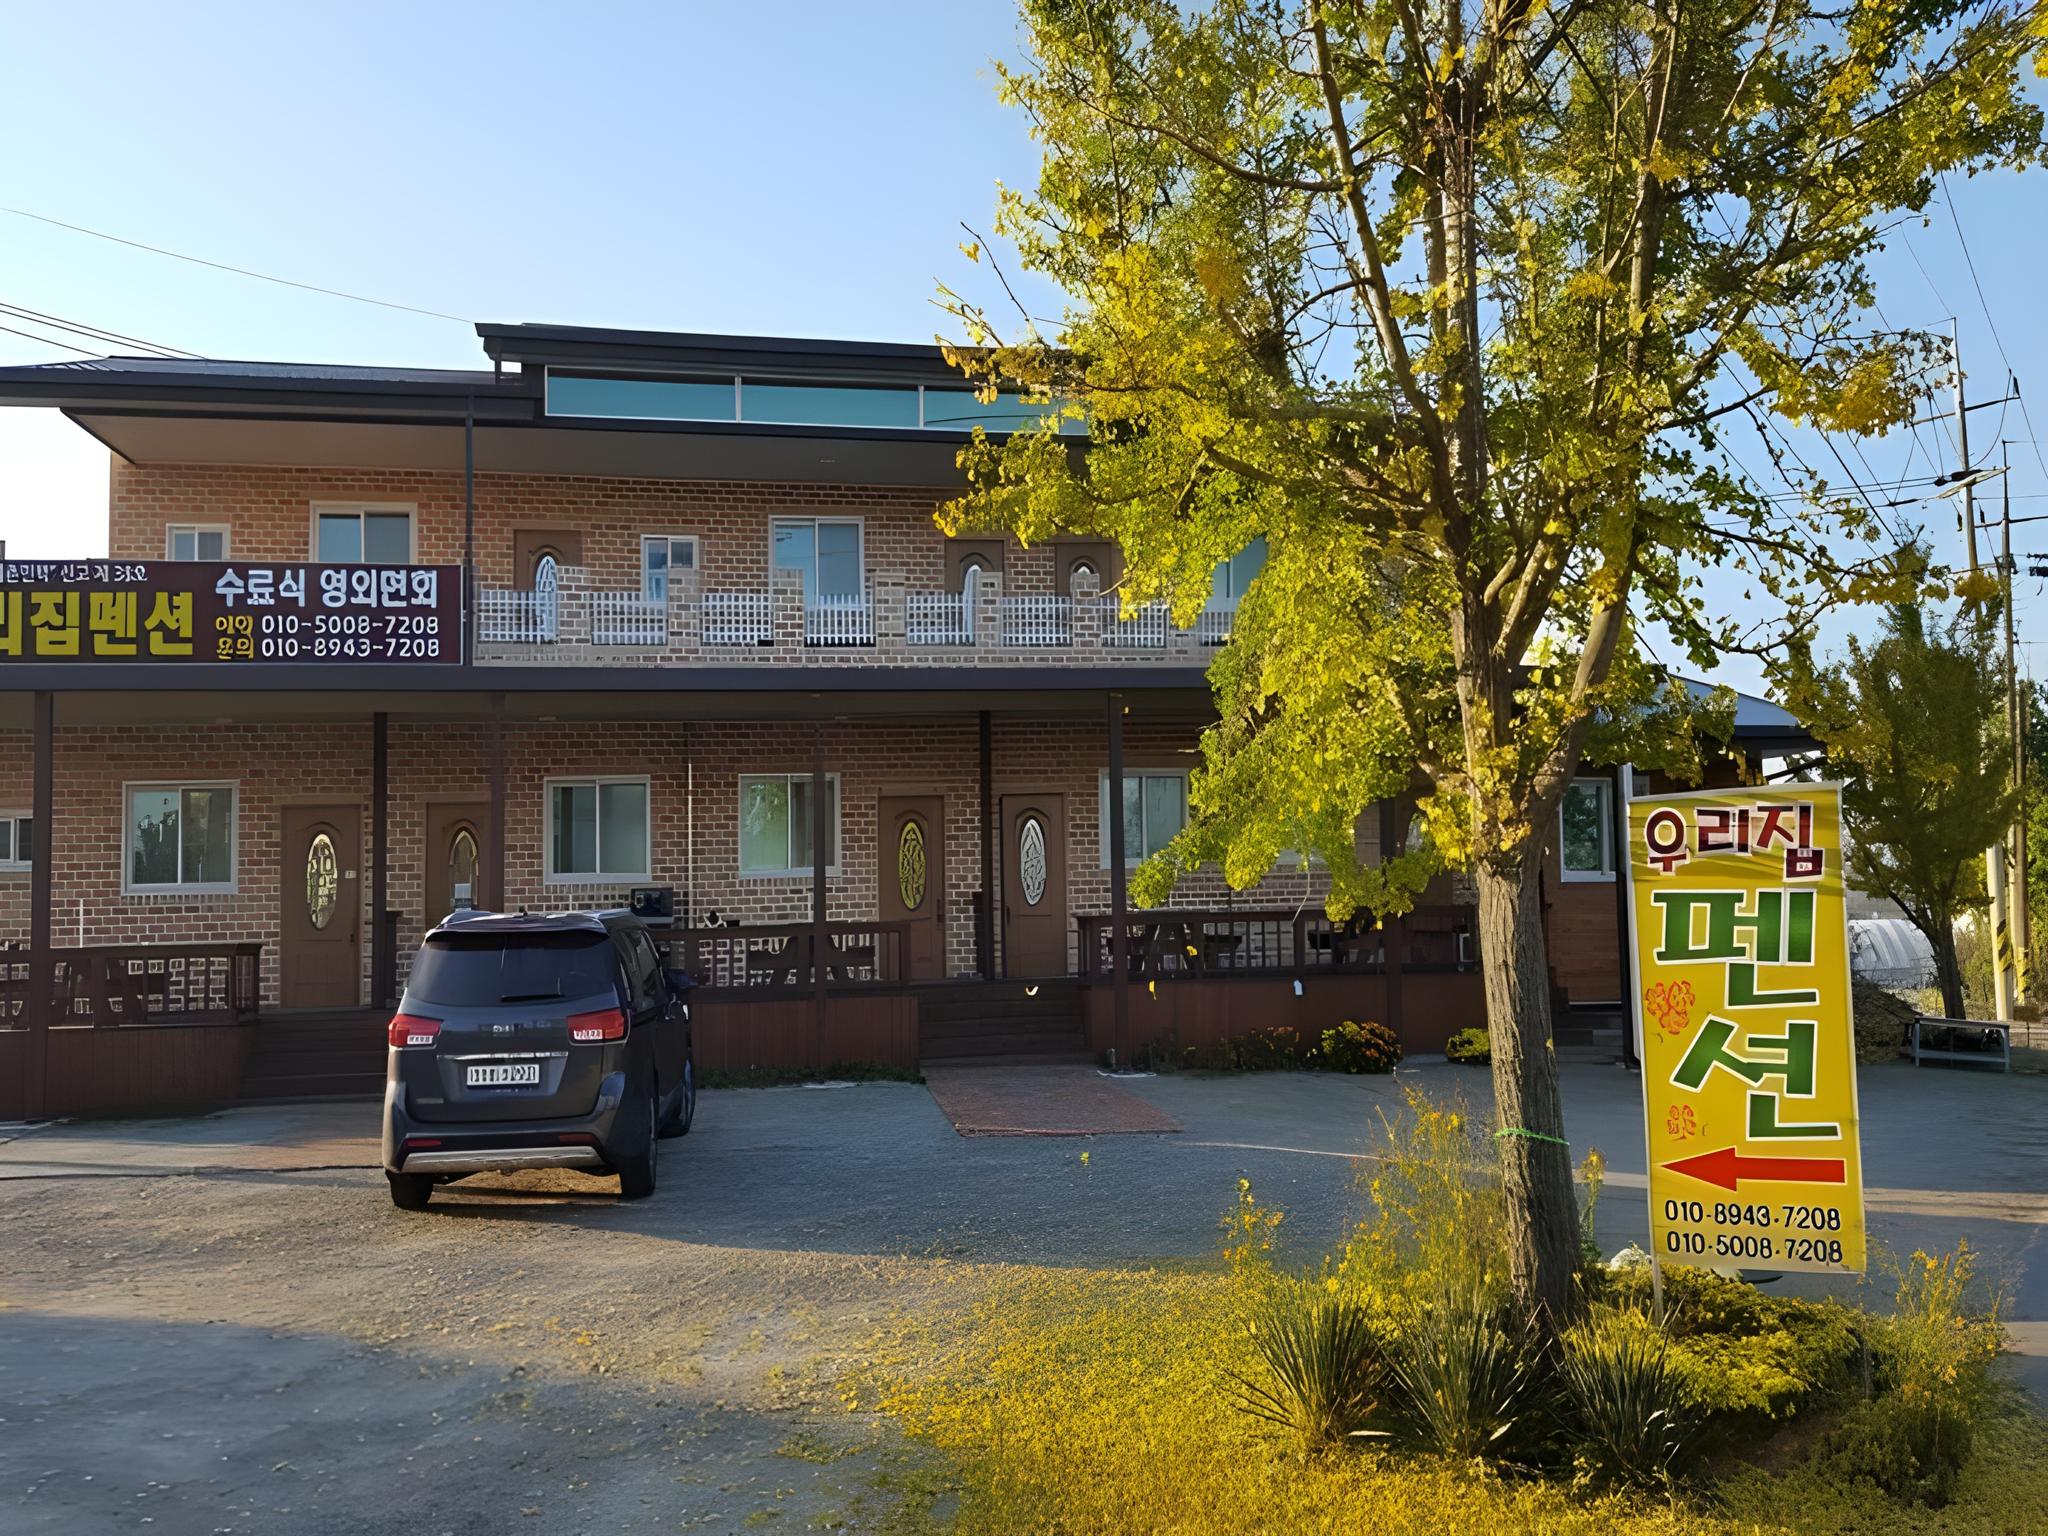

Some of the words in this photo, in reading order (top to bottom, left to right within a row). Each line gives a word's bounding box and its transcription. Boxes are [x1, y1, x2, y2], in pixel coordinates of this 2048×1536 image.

[215, 568, 305, 608] 수료식
[320, 568, 438, 609] 영외면회
[261, 615, 439, 635] 010-5008-7208
[261, 637, 440, 658] 010-8943-7208
[1645, 804, 1824, 880] 우리집
[1651, 890, 1842, 1140] 펜션
